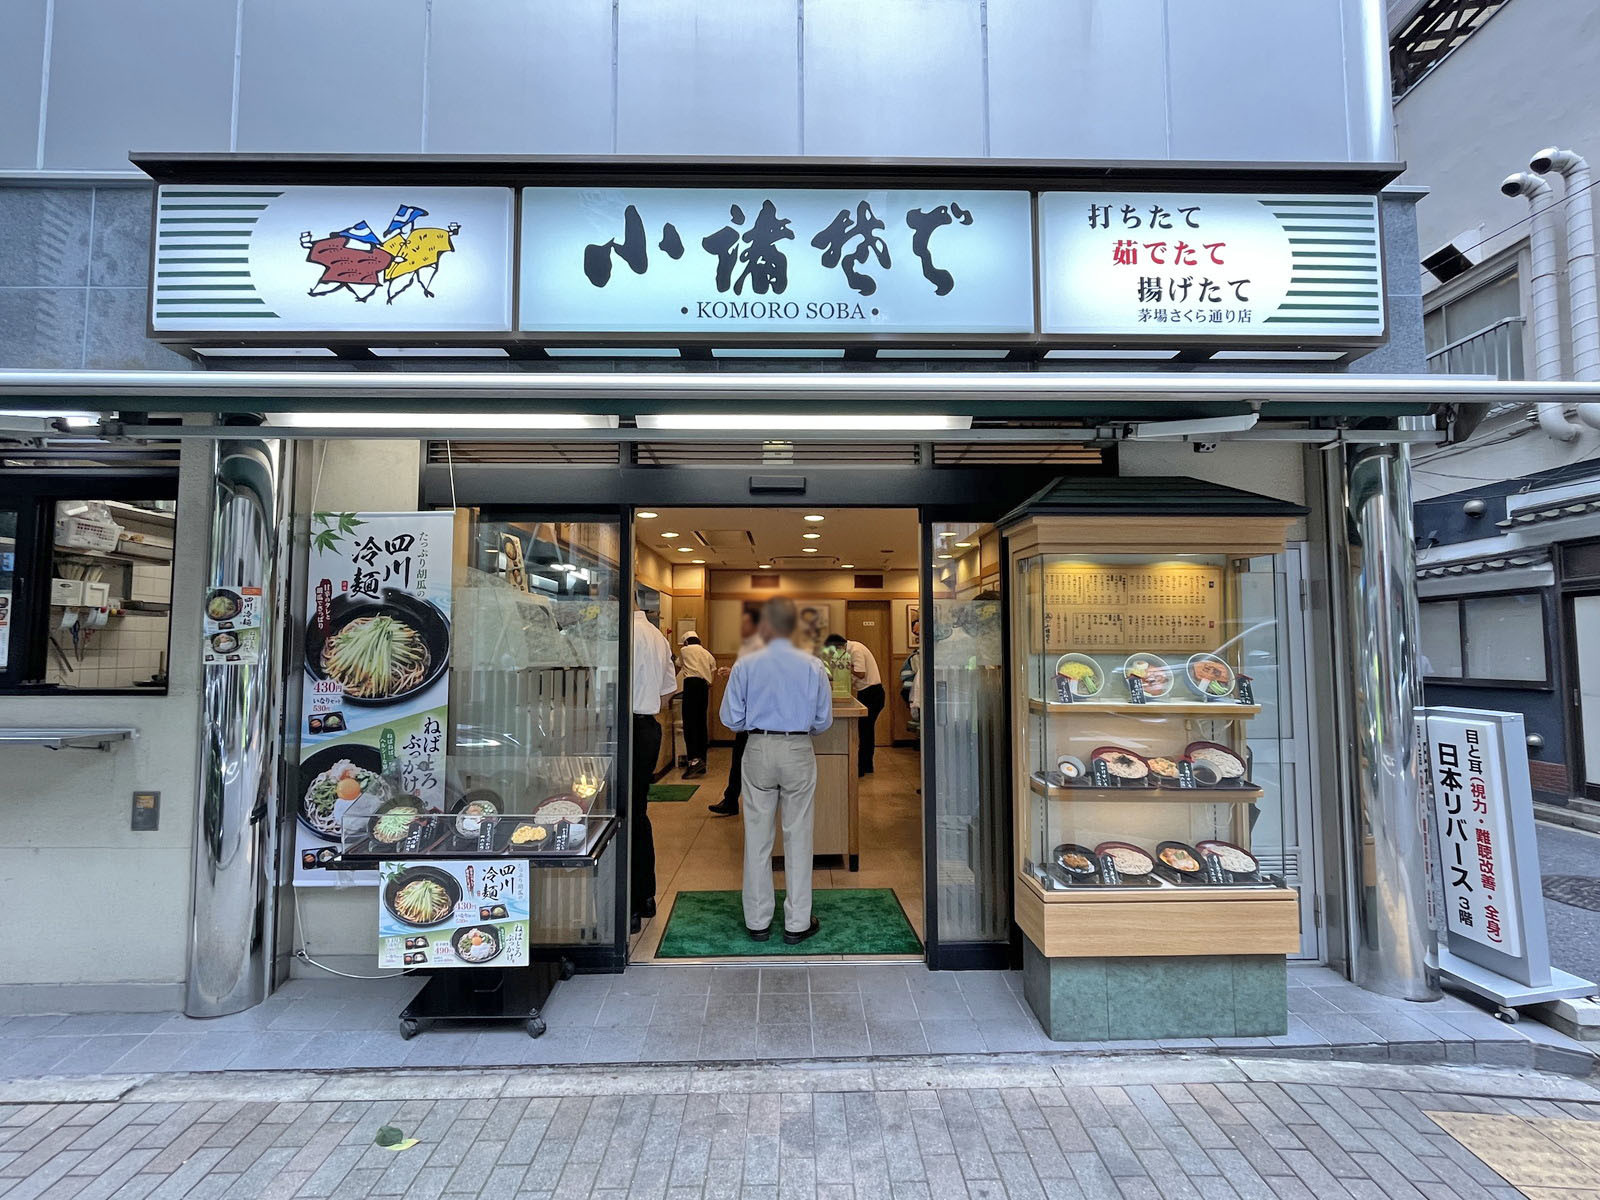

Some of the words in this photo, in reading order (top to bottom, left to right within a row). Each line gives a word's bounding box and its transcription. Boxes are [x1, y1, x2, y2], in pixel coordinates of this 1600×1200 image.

[1088, 203, 1201, 229] 打ちたて
[1112, 239, 1226, 266] 茹でたて
[1137, 276, 1251, 303] 揚げたて
[697, 301, 799, 320] KOMORO
[806, 302, 866, 320] SOBA
[1137, 308, 1252, 324] 茅場さくら通り店
[416, 531, 429, 598] たっぷり胡瓜の
[402, 734, 422, 793] ぶっかけ
